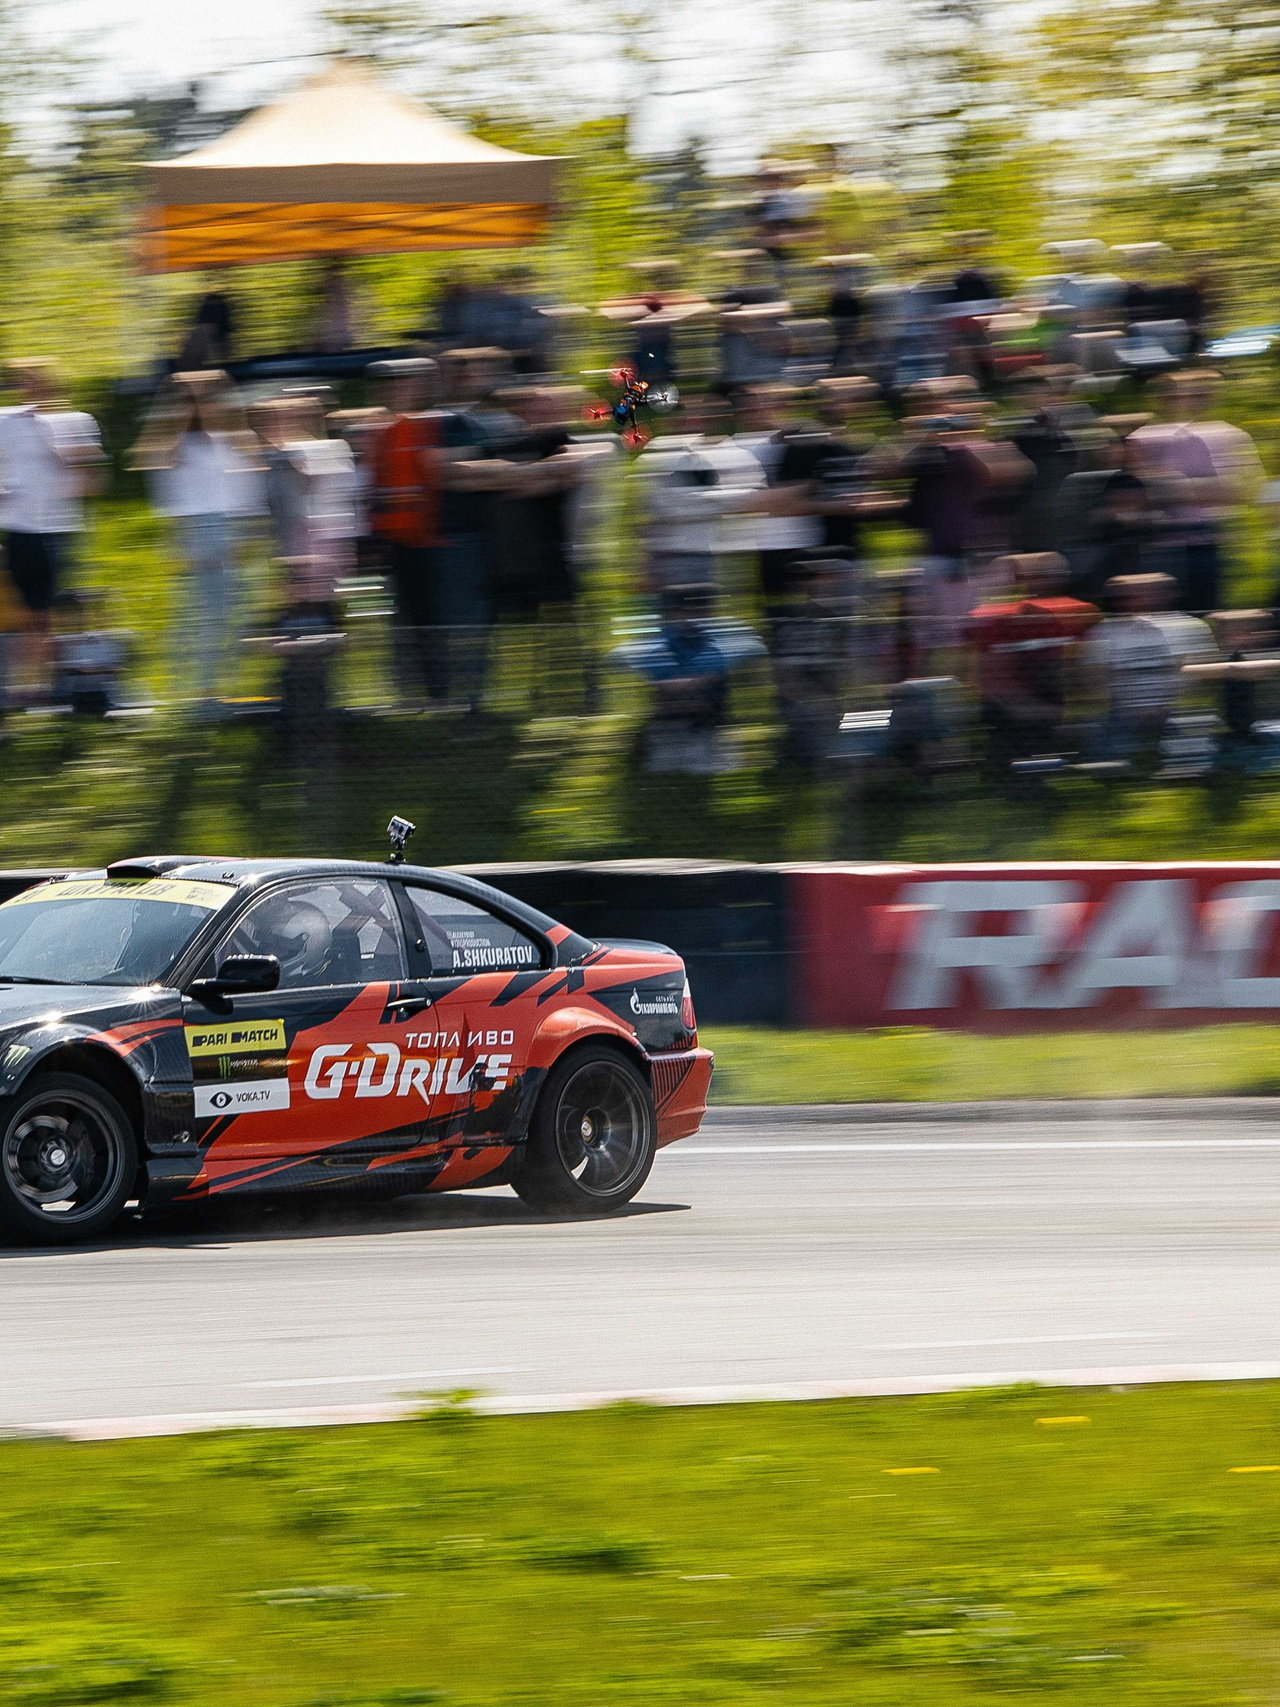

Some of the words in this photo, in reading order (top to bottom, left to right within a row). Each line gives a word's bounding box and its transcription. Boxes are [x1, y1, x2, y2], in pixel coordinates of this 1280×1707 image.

[452, 945, 533, 968] A.SHKURATOV
[231, 1028, 278, 1044] MATCH
[405, 1029, 514, 1049] ТОПЛИВО
[235, 1090, 271, 1103] VOKA.TV
